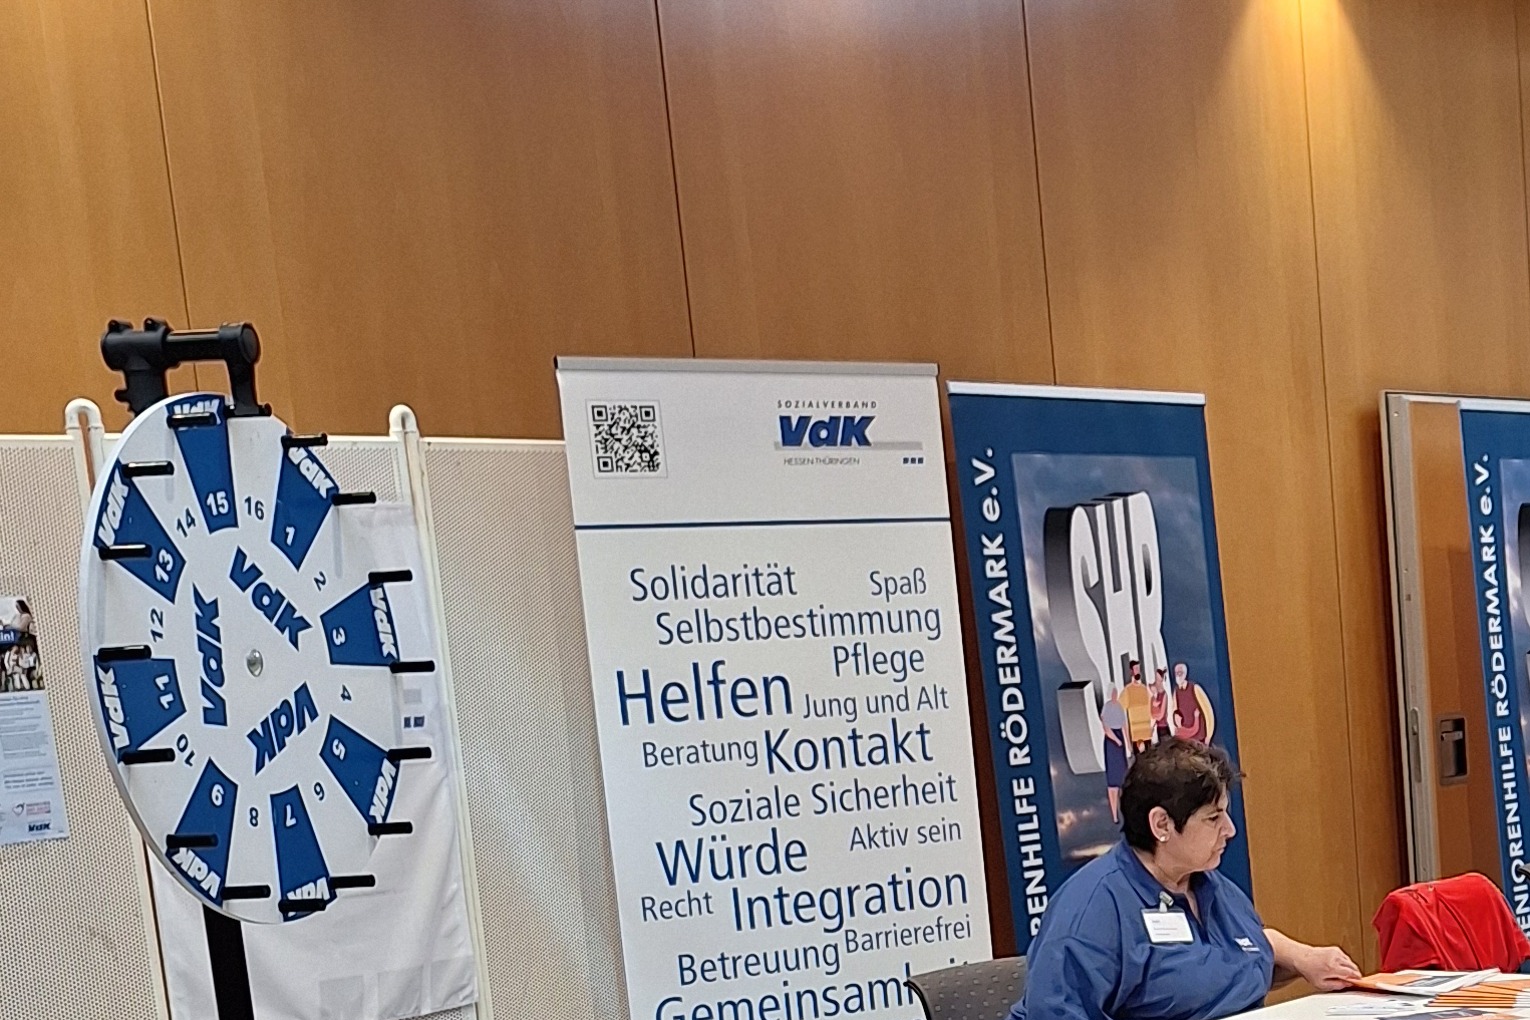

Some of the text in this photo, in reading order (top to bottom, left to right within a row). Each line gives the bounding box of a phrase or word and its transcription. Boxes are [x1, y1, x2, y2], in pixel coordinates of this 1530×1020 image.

[777, 400, 877, 409] SOZIALVERBAND
[778, 415, 876, 448] VdK
[206, 490, 229, 517] 15
[1474, 453, 1493, 516] e.V.
[98, 466, 129, 548] VdK
[175, 507, 197, 538] 14
[244, 496, 265, 520] 16
[285, 525, 298, 547] 1
[154, 552, 176, 584] 13
[313, 570, 328, 592] 2
[630, 563, 927, 602] Solidarität Spaß
[229, 544, 313, 651] VdK
[149, 608, 166, 644] 12
[331, 626, 346, 647] 3
[656, 604, 942, 645] Selbstbestimmung
[1479, 525, 1508, 720] RÖDERMARK
[192, 581, 229, 728] VdK
[832, 642, 925, 683] Pflege
[97, 666, 133, 752] VdK
[154, 675, 176, 710] 11
[339, 684, 353, 702] 4
[616, 660, 794, 726] Helfen
[803, 685, 950, 723] Jung und Alt
[971, 447, 1049, 936] RENHILFE RÖDERMARK e.V.
[246, 680, 320, 776] VdK
[642, 717, 934, 775] Beratung Kontakt
[175, 736, 197, 768] 10
[331, 738, 347, 760] 5
[210, 784, 225, 806] 9
[313, 782, 326, 801] 6
[689, 772, 958, 827] Soziale Sicherheit
[249, 807, 259, 827] 8
[285, 804, 297, 828] 7
[656, 817, 962, 887] Würde Aktiv sein
[172, 847, 221, 899] VdK
[641, 866, 968, 934] Recht Integration
[678, 914, 972, 986] Betreuung Barrierefrei
